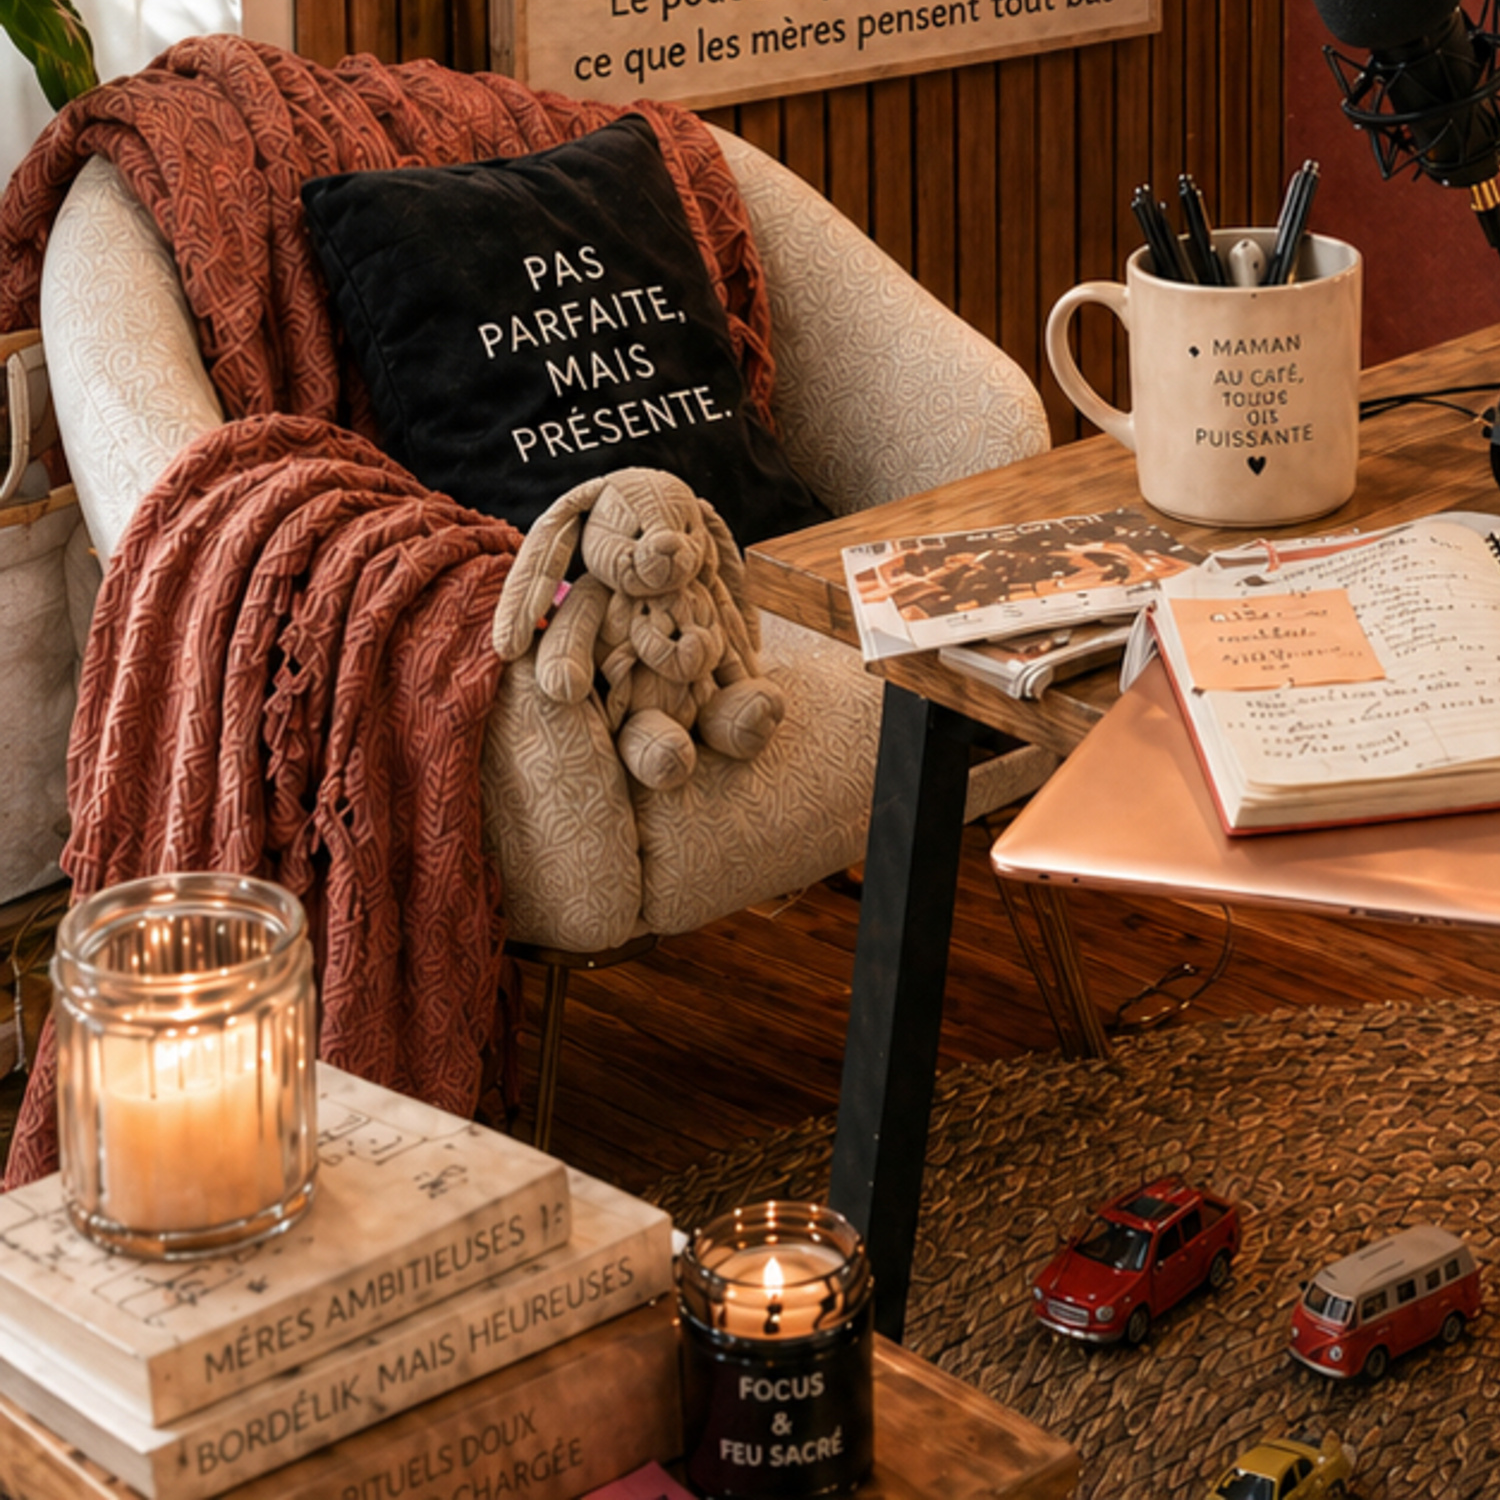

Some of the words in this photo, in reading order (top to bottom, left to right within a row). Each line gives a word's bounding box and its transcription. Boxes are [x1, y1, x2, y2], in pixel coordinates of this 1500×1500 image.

[574, 51, 612, 81] ce
[624, 41, 687, 83] que
[698, 27, 740, 64] les
[751, 15, 846, 57] mères
[522, 245, 605, 292] PAS
[478, 286, 686, 359] PARFAITE,
[1213, 334, 1301, 356] MAMAN
[545, 343, 655, 398] MAIS
[1214, 370, 1243, 386] AU
[511, 386, 732, 463] PRÉSENTE.
[1195, 424, 1313, 448] PUISSANTE
[325, 1215, 526, 1328] AMBITIEUSES
[196, 1374, 363, 1476] BORDÉLIK
[376, 1333, 457, 1393] MAIS
[468, 1256, 635, 1354] HEUREUSES
[740, 1373, 824, 1400] FOCUS
[460, 1407, 537, 1468] DOUX
[720, 1439, 762, 1466] FEU
[770, 1426, 843, 1467] SACRÉ
[771, 1412, 792, 1436] &
